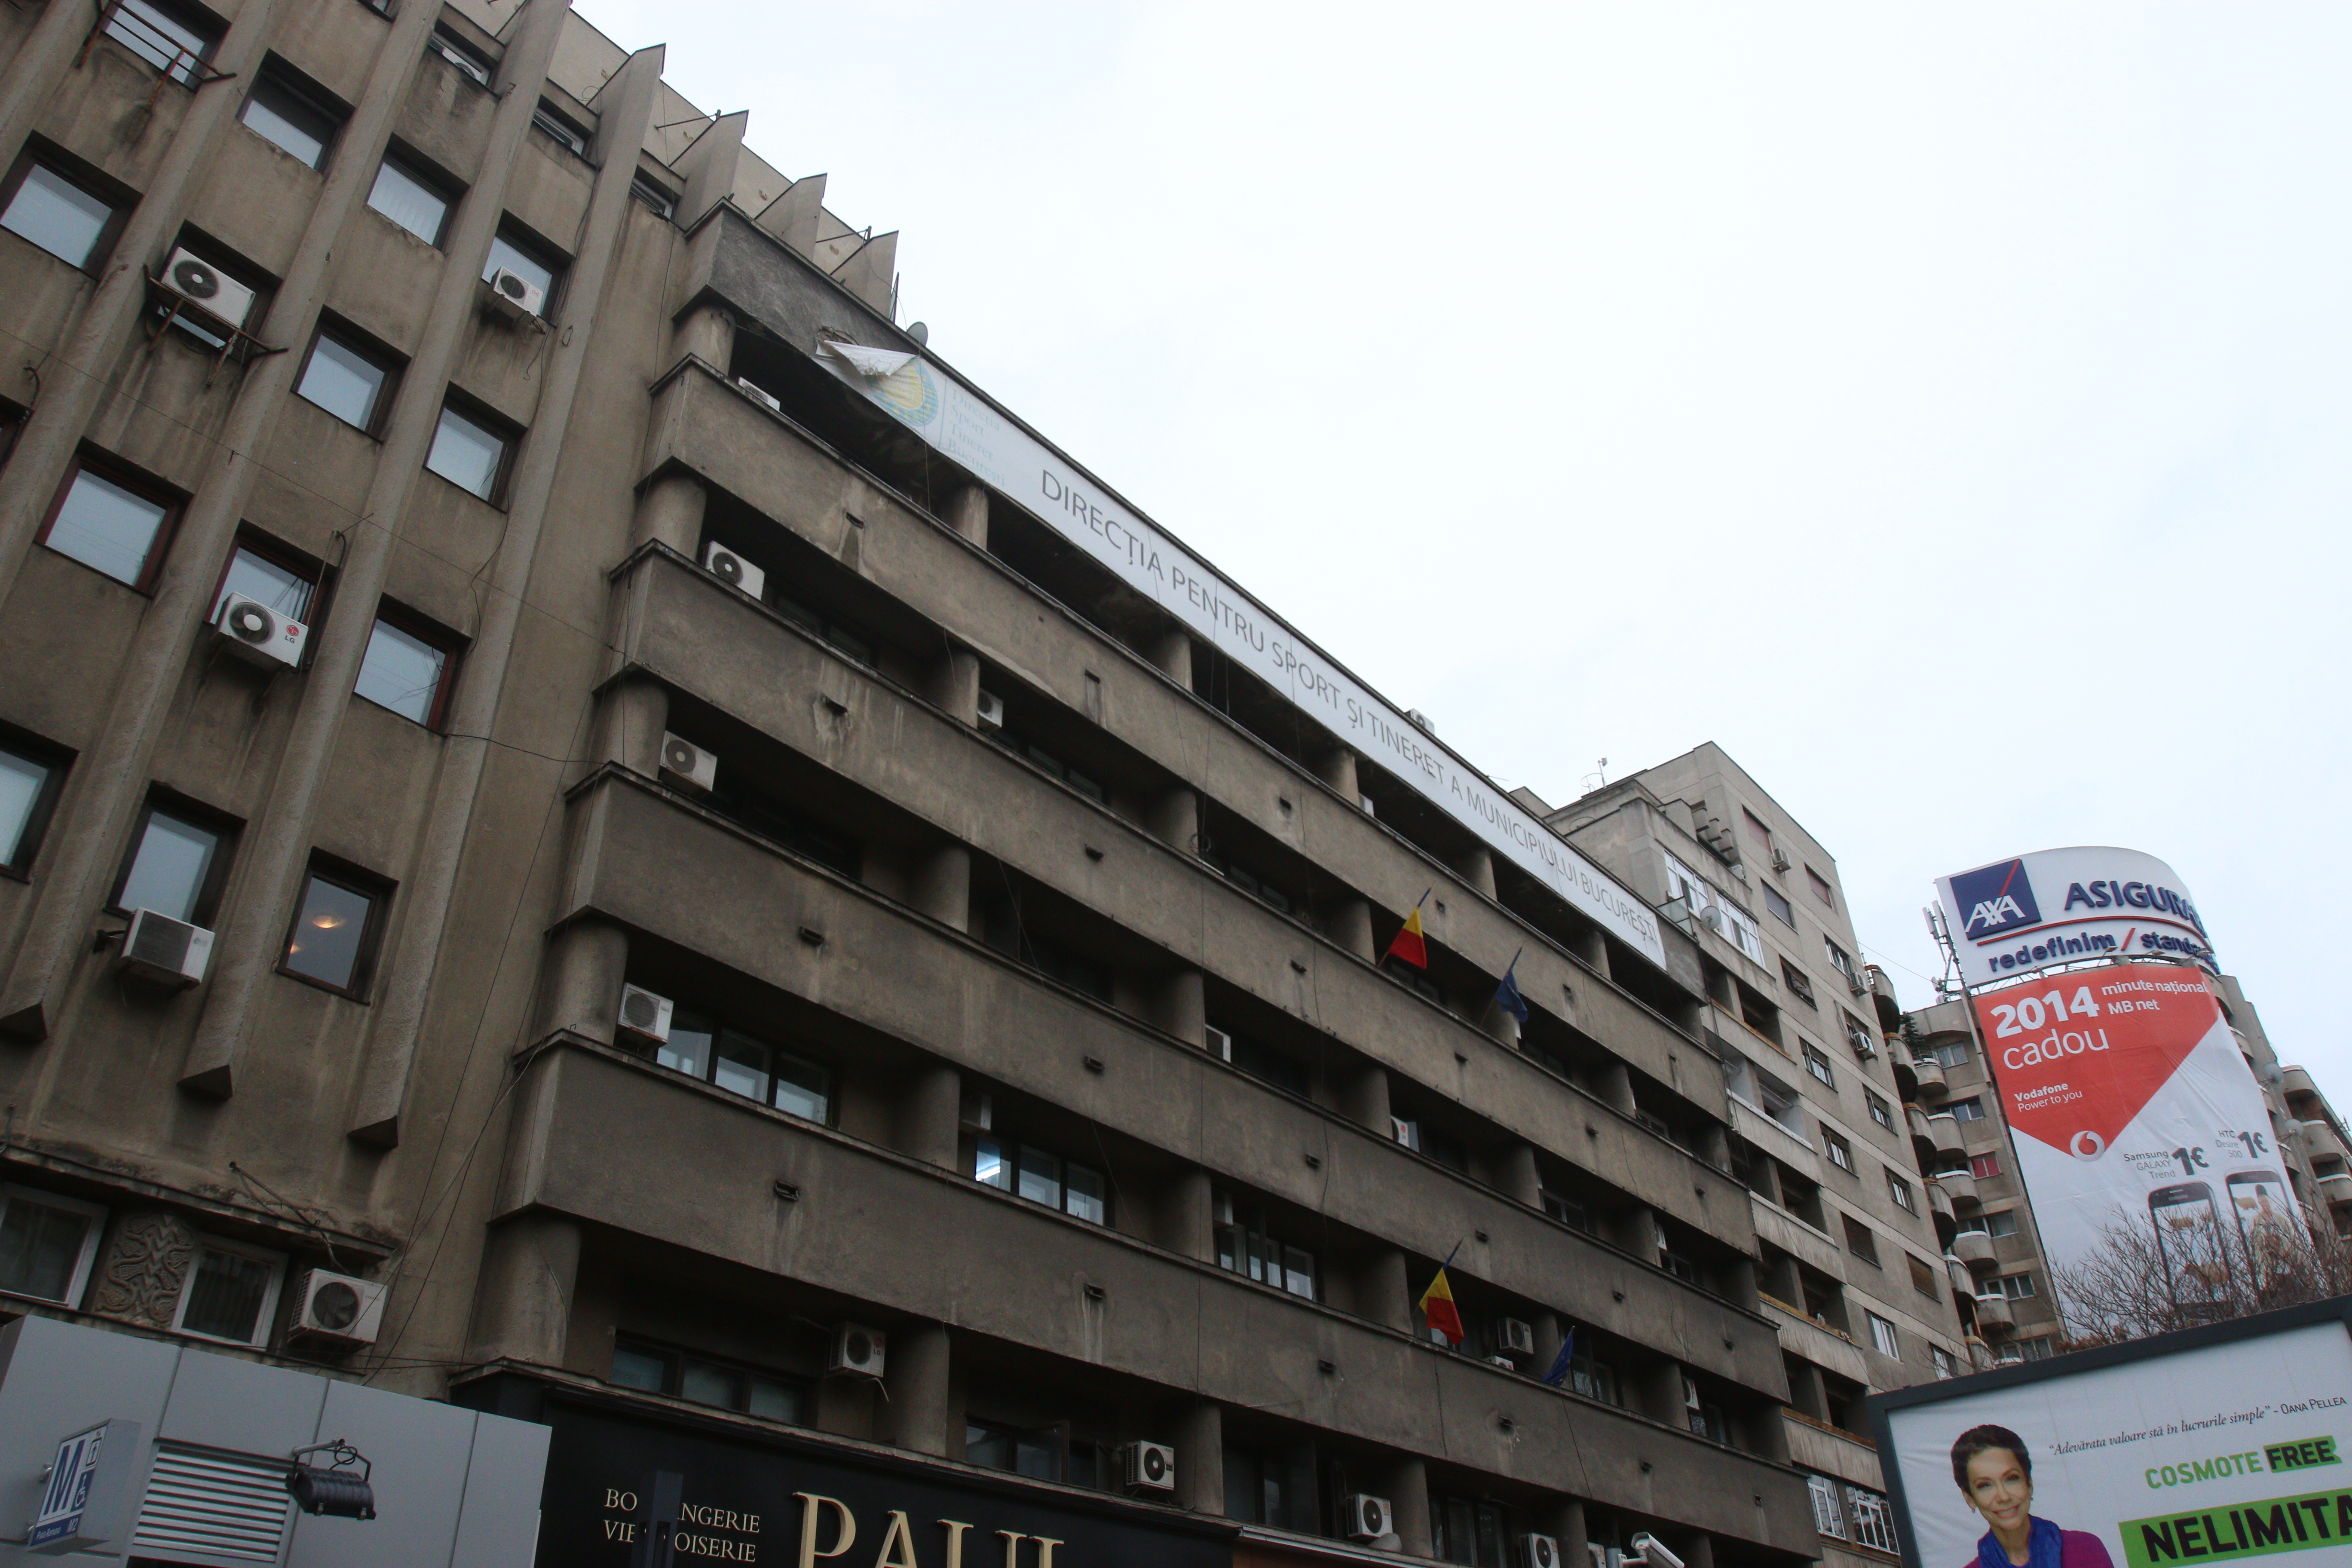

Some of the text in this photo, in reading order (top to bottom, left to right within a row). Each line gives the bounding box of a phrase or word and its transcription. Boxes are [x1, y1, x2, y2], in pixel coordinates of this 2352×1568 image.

[285, 634, 295, 643] LG
[1042, 469, 1164, 581] DIRECȚIA
[1173, 566, 1264, 652] PENTRU
[1272, 642, 1341, 709] SPORT
[1367, 711, 1444, 784] TINERET
[1452, 775, 1463, 801] A
[1467, 786, 1578, 886] MUNICIPIULUI
[1965, 894, 2026, 933] AXA
[1988, 932, 2116, 972] redefinim
[1990, 986, 2100, 1039] 2014
[2101, 980, 2153, 996] minute
[2107, 998, 2161, 1015] MB net
[2003, 1028, 2110, 1070] cadou
[2014, 1083, 2069, 1102] Vodafone
[2018, 1090, 2083, 1112] Power to you
[2215, 1139, 2239, 1149] Desire
[2218, 1130, 2236, 1139] HTC
[2123, 1150, 2169, 1162] Samsung
[2136, 1159, 2171, 1171] GALAXY
[2148, 1170, 2176, 1179] Trend
[2109, 1431, 2146, 1446] valoare
[2149, 1426, 2164, 1438] stă
[2166, 1424, 2178, 1435] în
[2181, 1413, 2226, 1432] lucrurile
[43, 1438, 86, 1516] M
[2145, 1440, 2335, 1489] COSMOTE FREE
[603, 1488, 760, 1533] BONGERIE
[603, 1519, 756, 1562] VIEOISERIE
